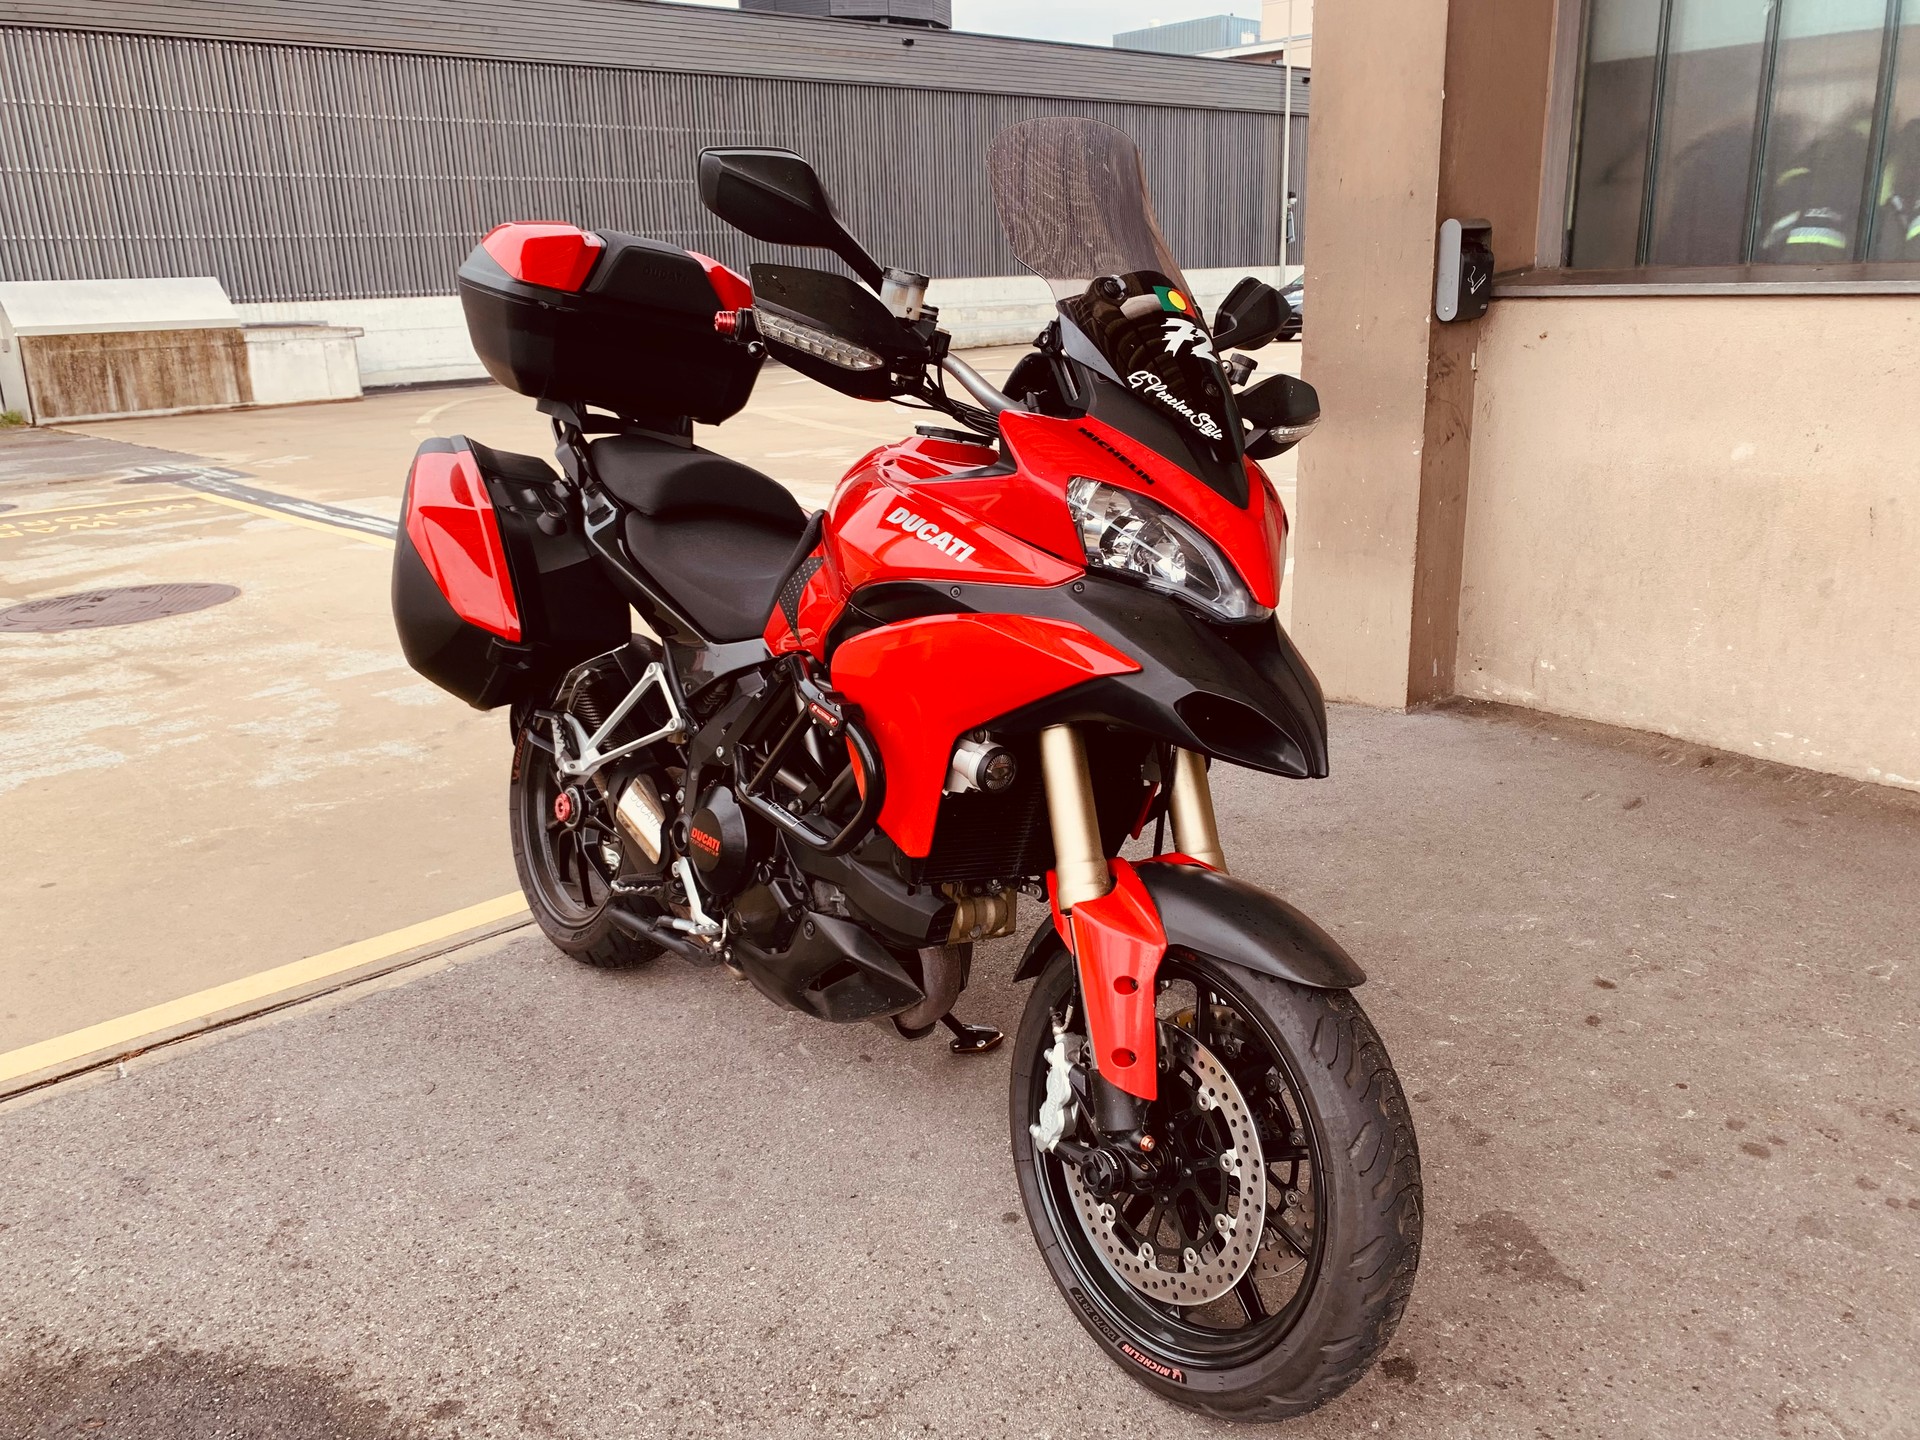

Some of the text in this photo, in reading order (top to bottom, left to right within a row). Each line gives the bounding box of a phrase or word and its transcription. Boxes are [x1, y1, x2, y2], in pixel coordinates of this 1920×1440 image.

[1161, 318, 1218, 363] 72
[1078, 427, 1155, 485] MICHELIN
[885, 506, 976, 563] DUCATI
[630, 796, 659, 828] DUCATI
[690, 827, 720, 851] DUCATI
[1074, 1293, 1117, 1341] 120/70 ZR 17
[1121, 1343, 1171, 1377] MICHELIN
